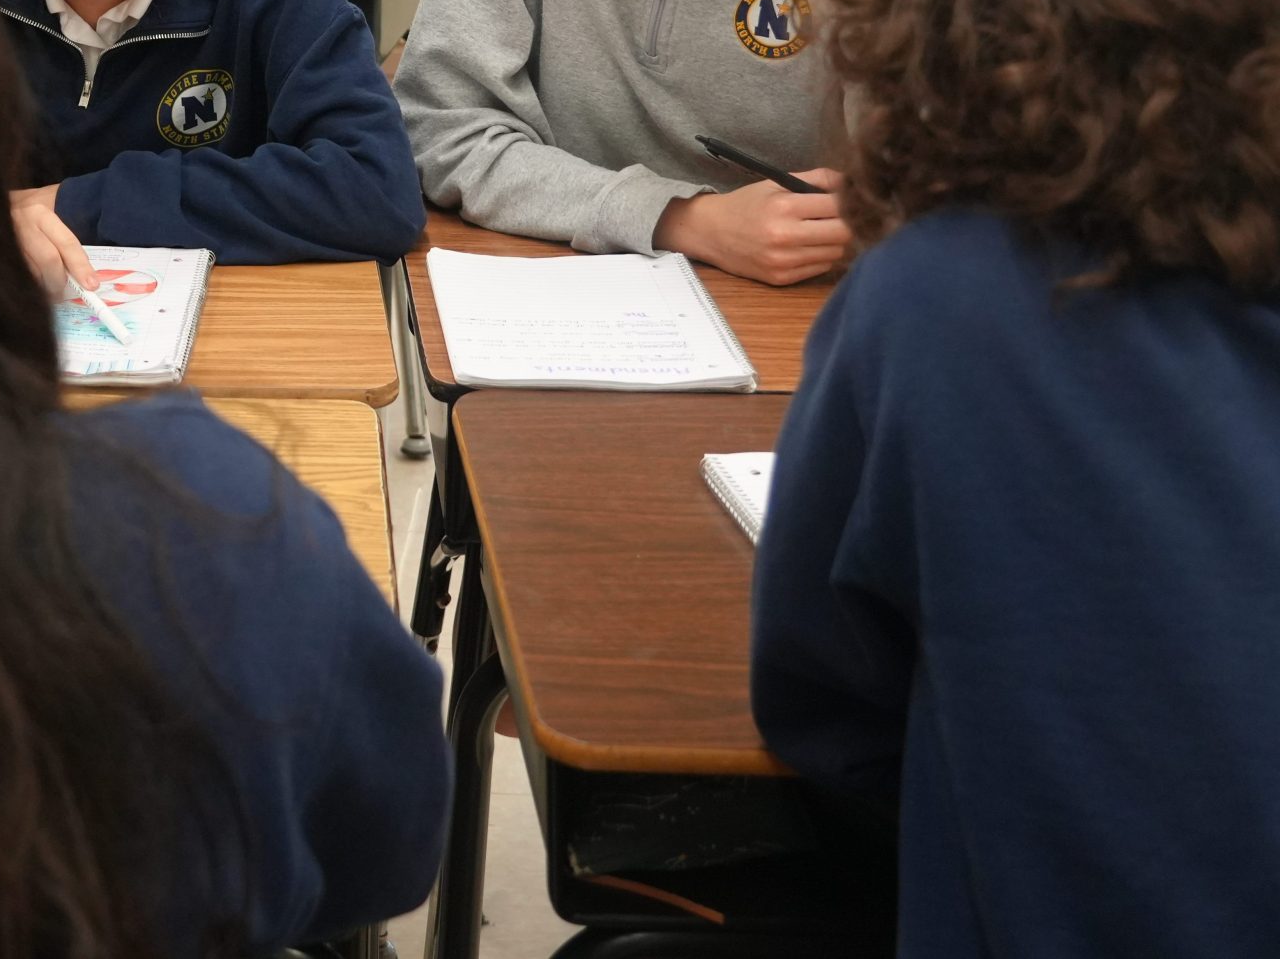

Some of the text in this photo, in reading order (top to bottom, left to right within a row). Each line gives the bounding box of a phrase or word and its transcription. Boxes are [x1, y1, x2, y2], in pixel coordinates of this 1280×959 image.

[736, 21, 769, 57] NORTH
[163, 73, 233, 107] NOTRE DAME
[181, 96, 218, 131] N
[162, 124, 199, 144] NORTH
